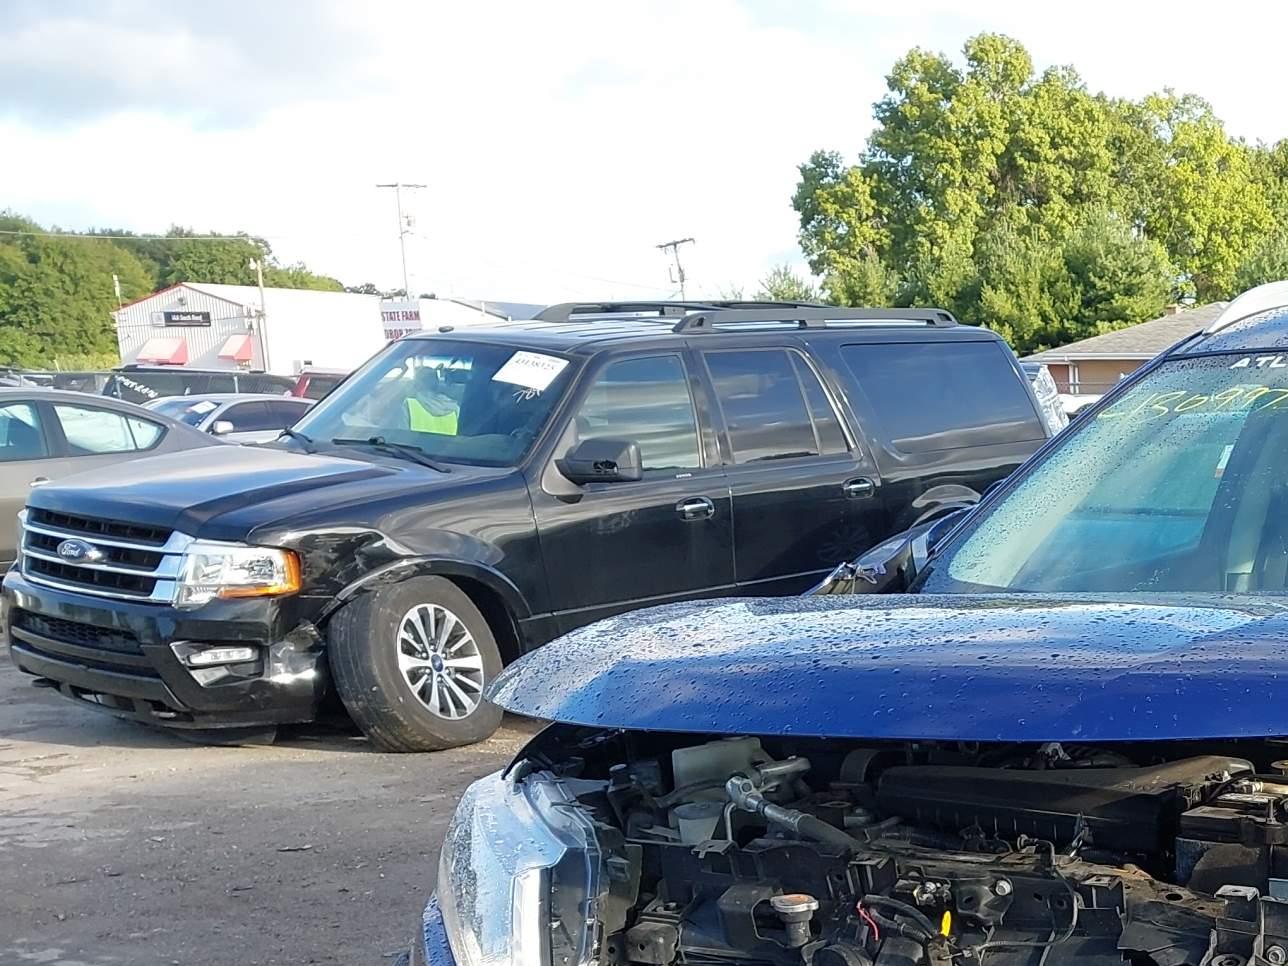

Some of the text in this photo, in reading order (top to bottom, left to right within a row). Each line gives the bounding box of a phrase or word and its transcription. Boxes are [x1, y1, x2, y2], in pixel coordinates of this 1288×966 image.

[381, 311, 420, 321] STATE FARM
[61, 542, 81, 557] Ford
